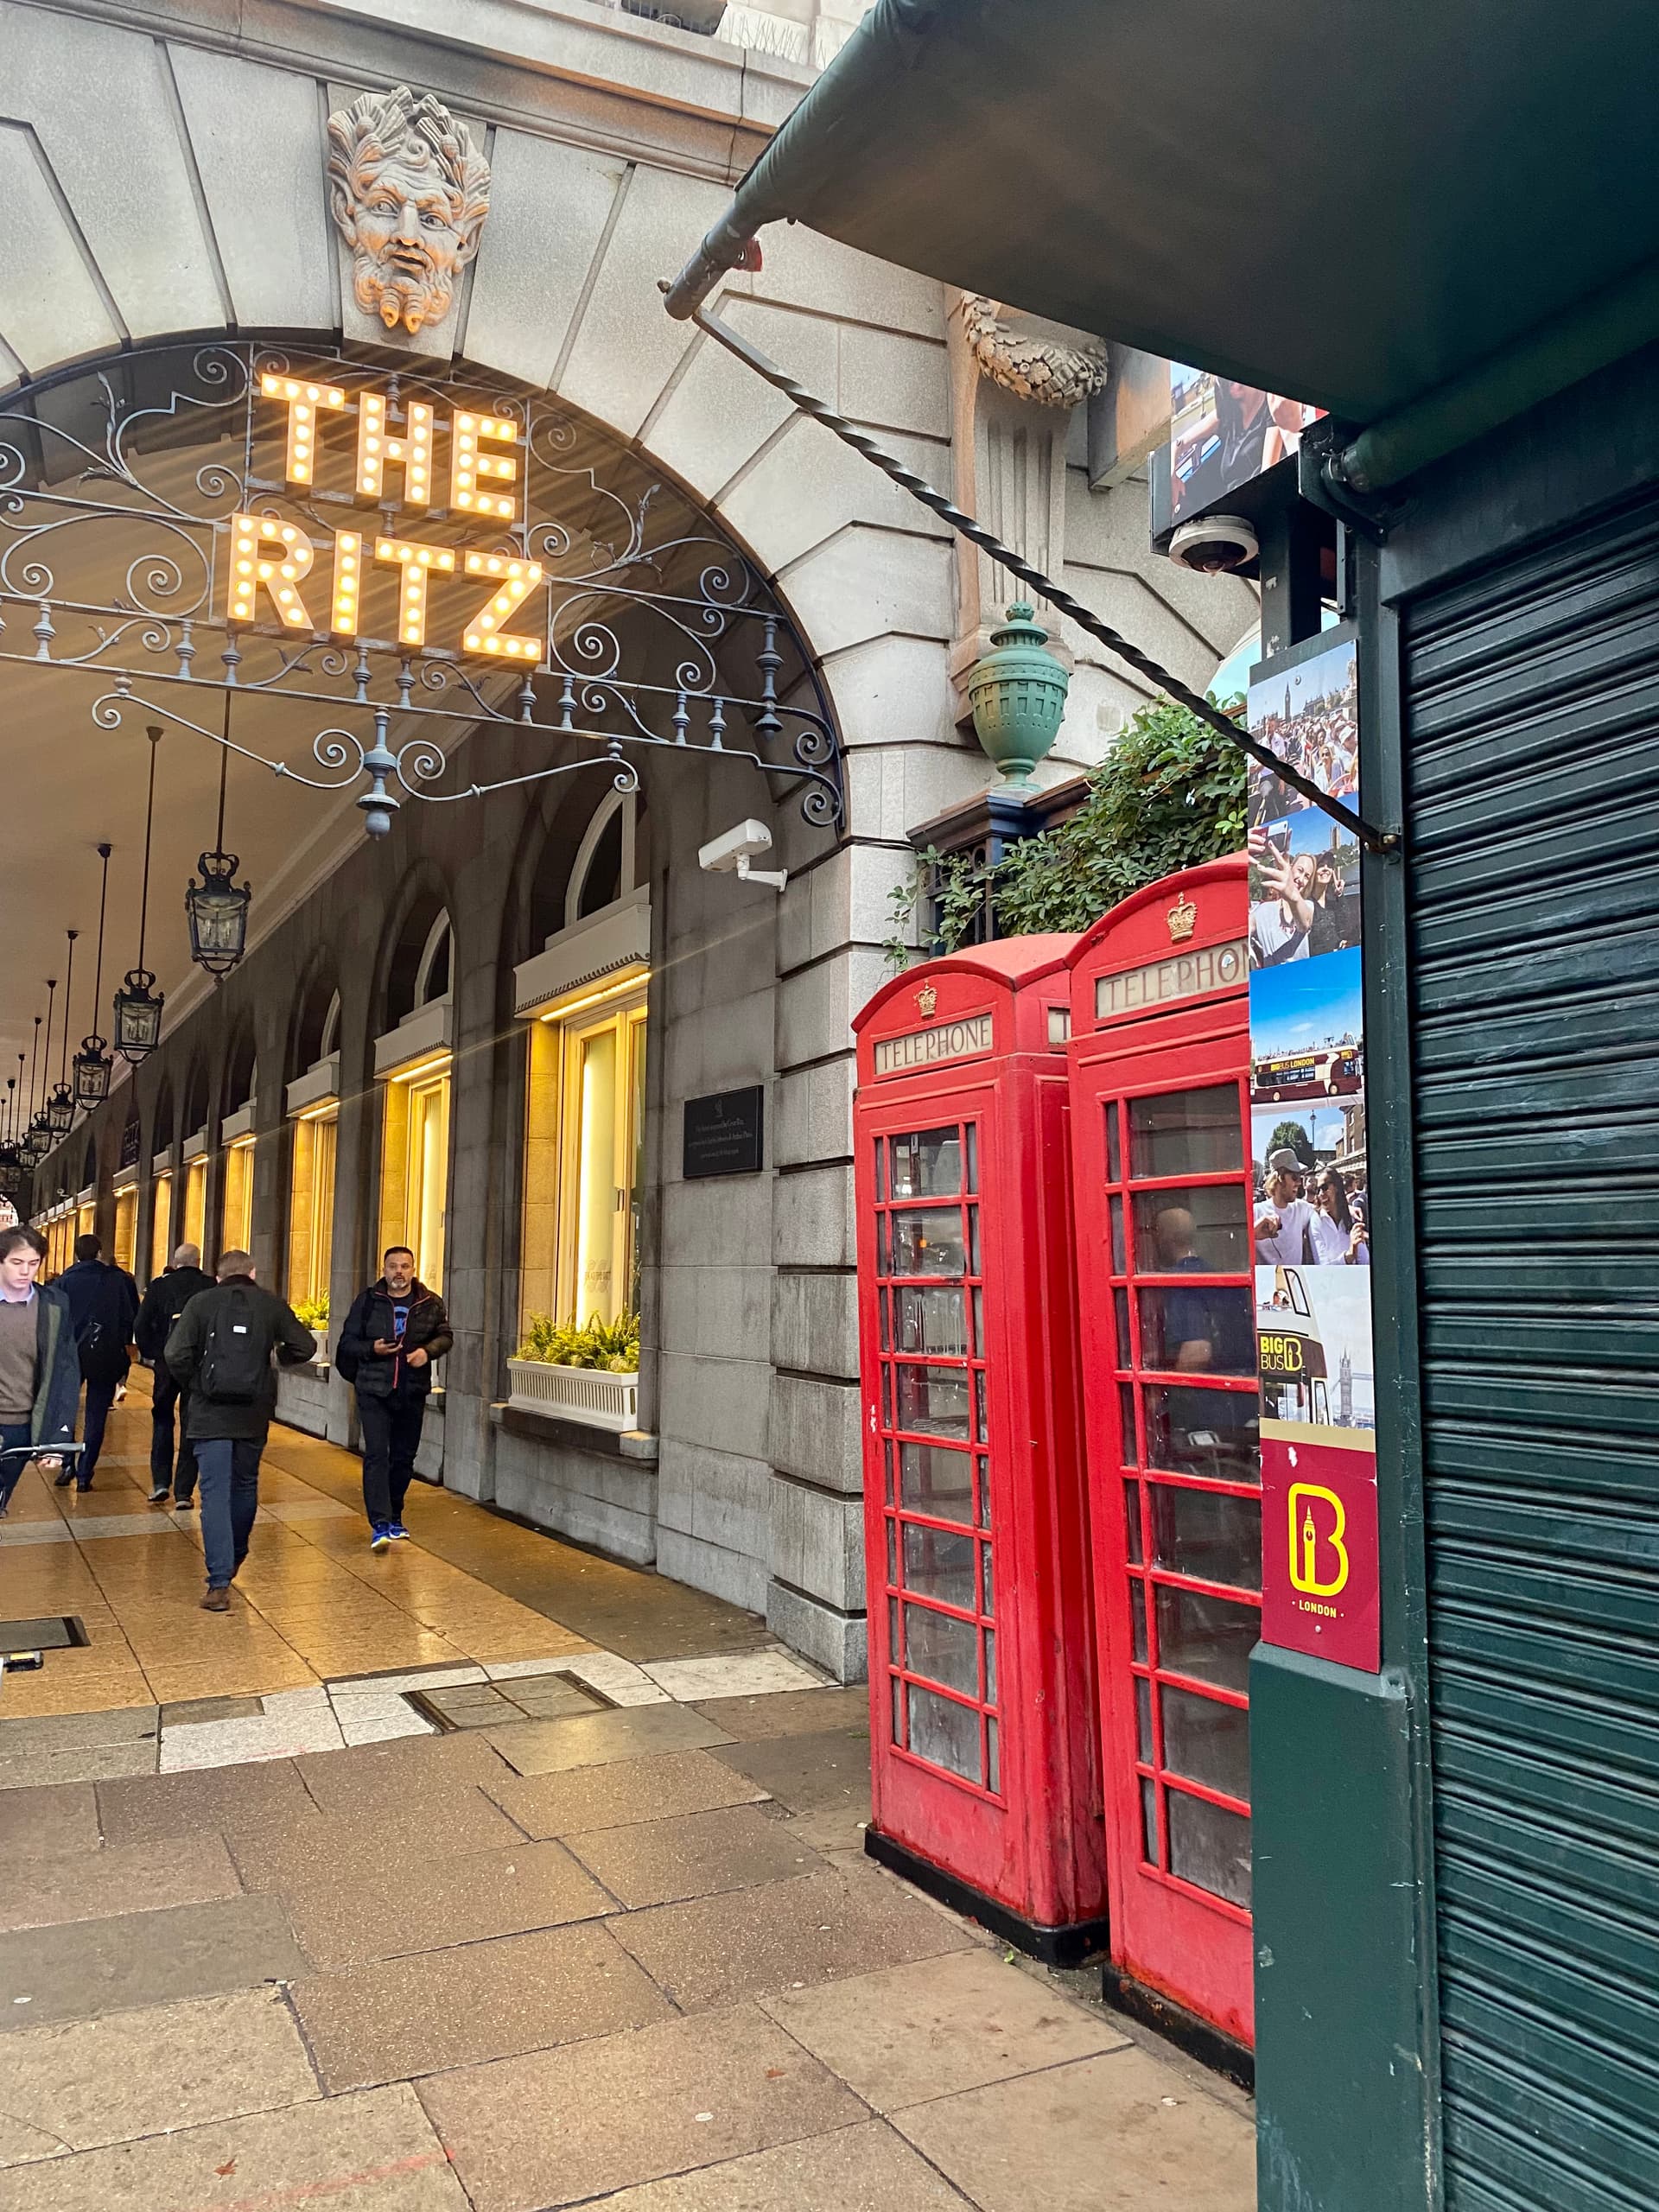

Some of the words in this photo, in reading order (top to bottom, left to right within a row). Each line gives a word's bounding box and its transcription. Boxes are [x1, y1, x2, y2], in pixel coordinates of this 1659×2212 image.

[262, 373, 517, 518] THE
[228, 513, 542, 661] RITZ
[881, 1019, 991, 1070] TELEPHONE
[1291, 1058, 1314, 1068] LONDON
[1261, 1337, 1283, 1354] BIG
[1261, 1354, 1284, 1370] BUS
[1299, 1599, 1337, 1618] LONDON
